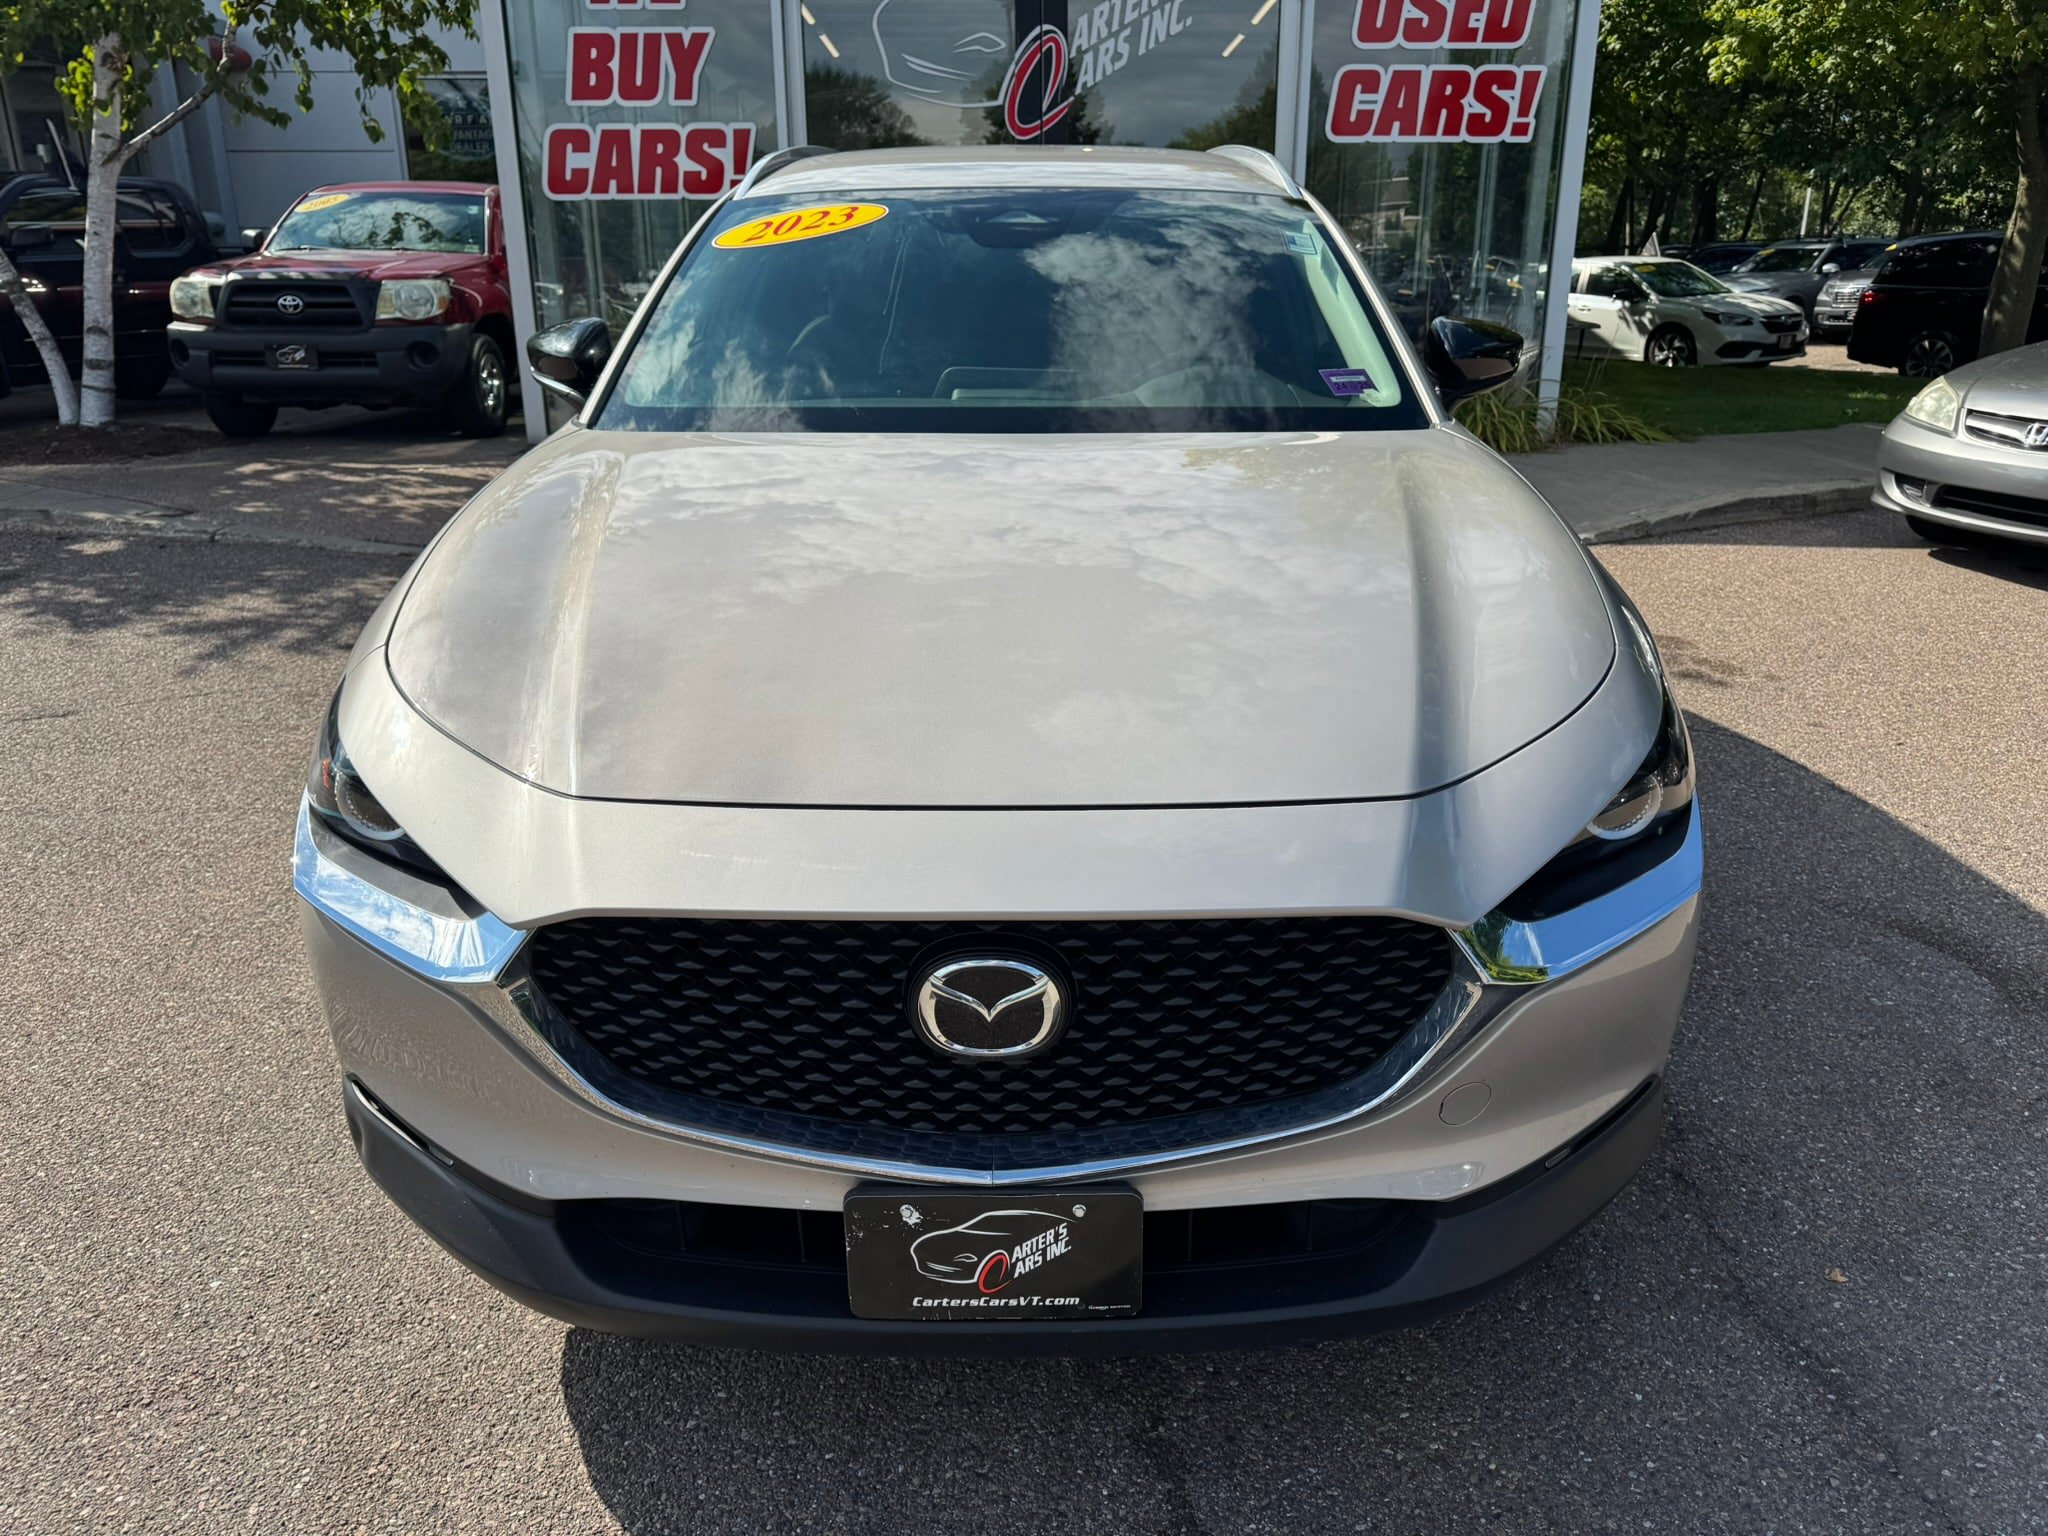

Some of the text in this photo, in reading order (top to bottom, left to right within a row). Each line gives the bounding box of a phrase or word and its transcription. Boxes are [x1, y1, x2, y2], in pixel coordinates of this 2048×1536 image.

[1074, 0, 1193, 96] ARS INC.
[1355, 0, 1537, 44] USED
[570, 32, 710, 101] BUY
[1329, 69, 1543, 137] CARS!
[546, 128, 752, 195] CARS!
[741, 206, 859, 243] 2023
[1013, 1236, 1072, 1279] ARS INC.
[912, 1296, 1080, 1308] CartersCarsVT.com
